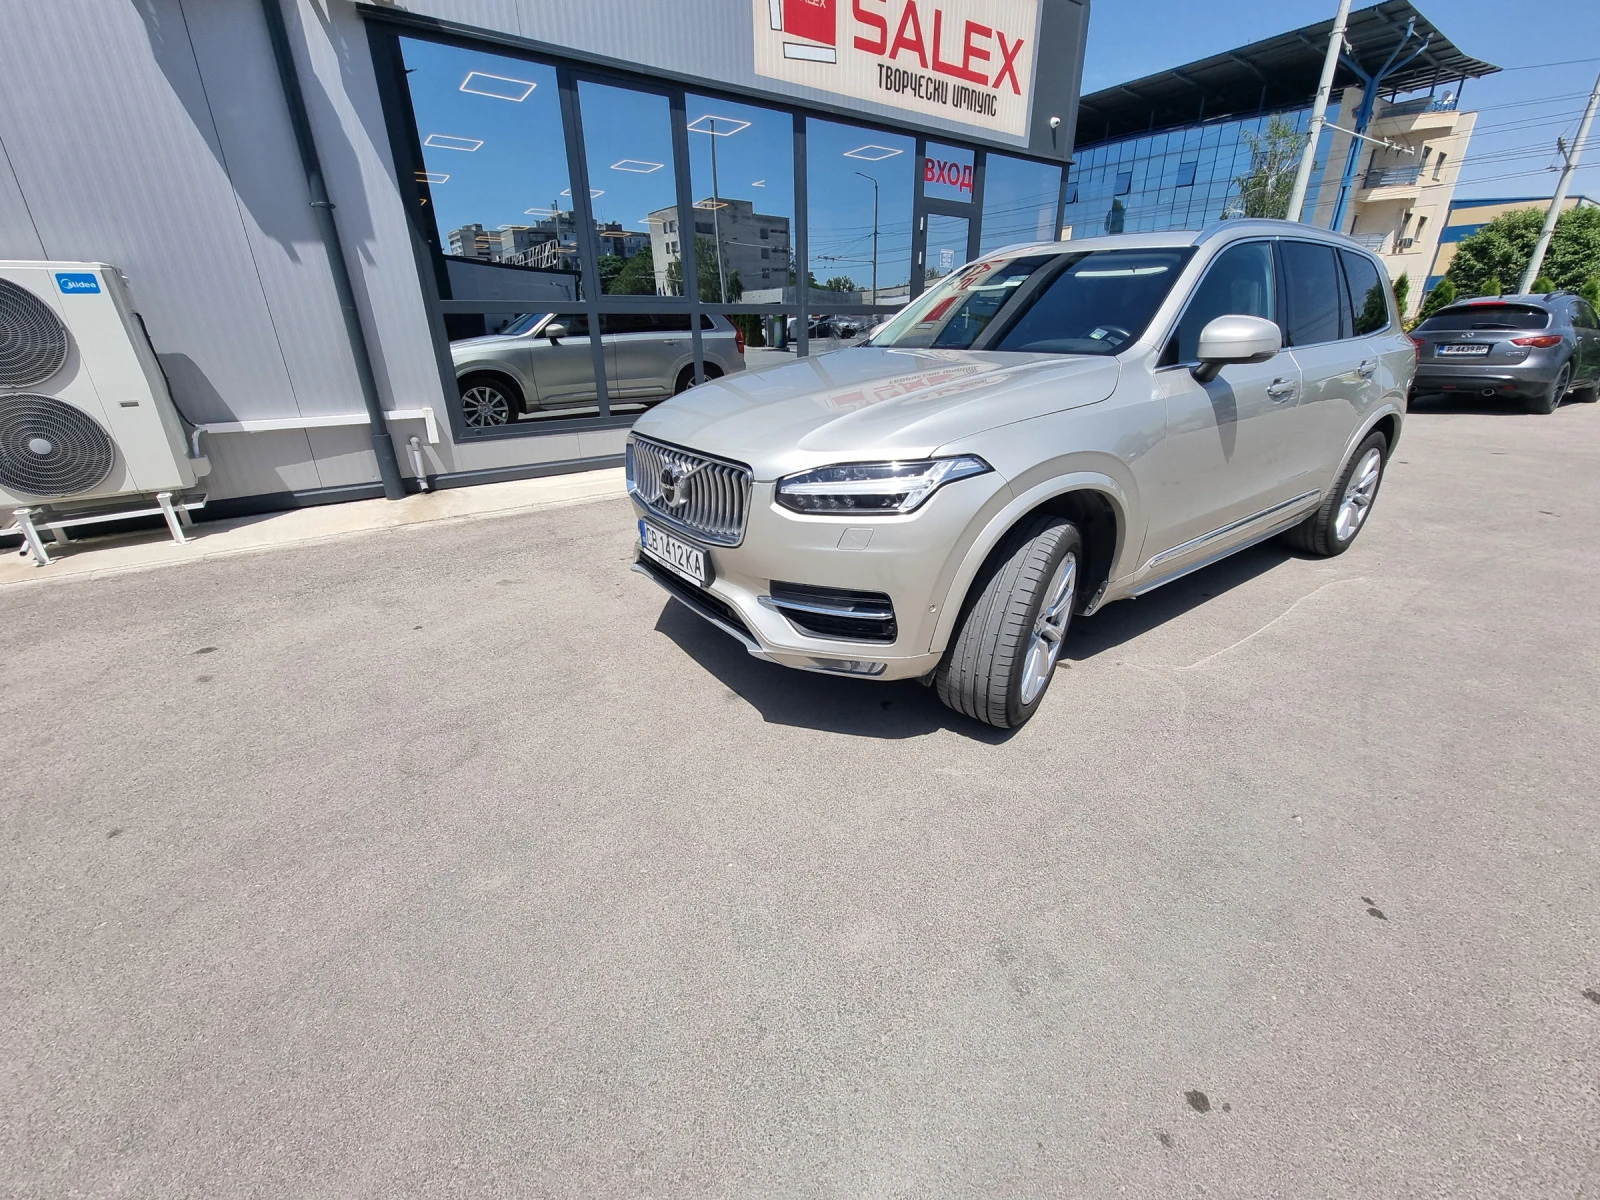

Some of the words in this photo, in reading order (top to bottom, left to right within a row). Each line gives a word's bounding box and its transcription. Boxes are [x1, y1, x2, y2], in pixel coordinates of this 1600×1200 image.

[852, 0, 1025, 96] SALEX
[877, 63, 949, 105] ТВОРЧЕСКИ
[952, 83, 998, 117] ИМПУЛС
[924, 157, 974, 194] ВХОД
[64, 280, 97, 289] Midea
